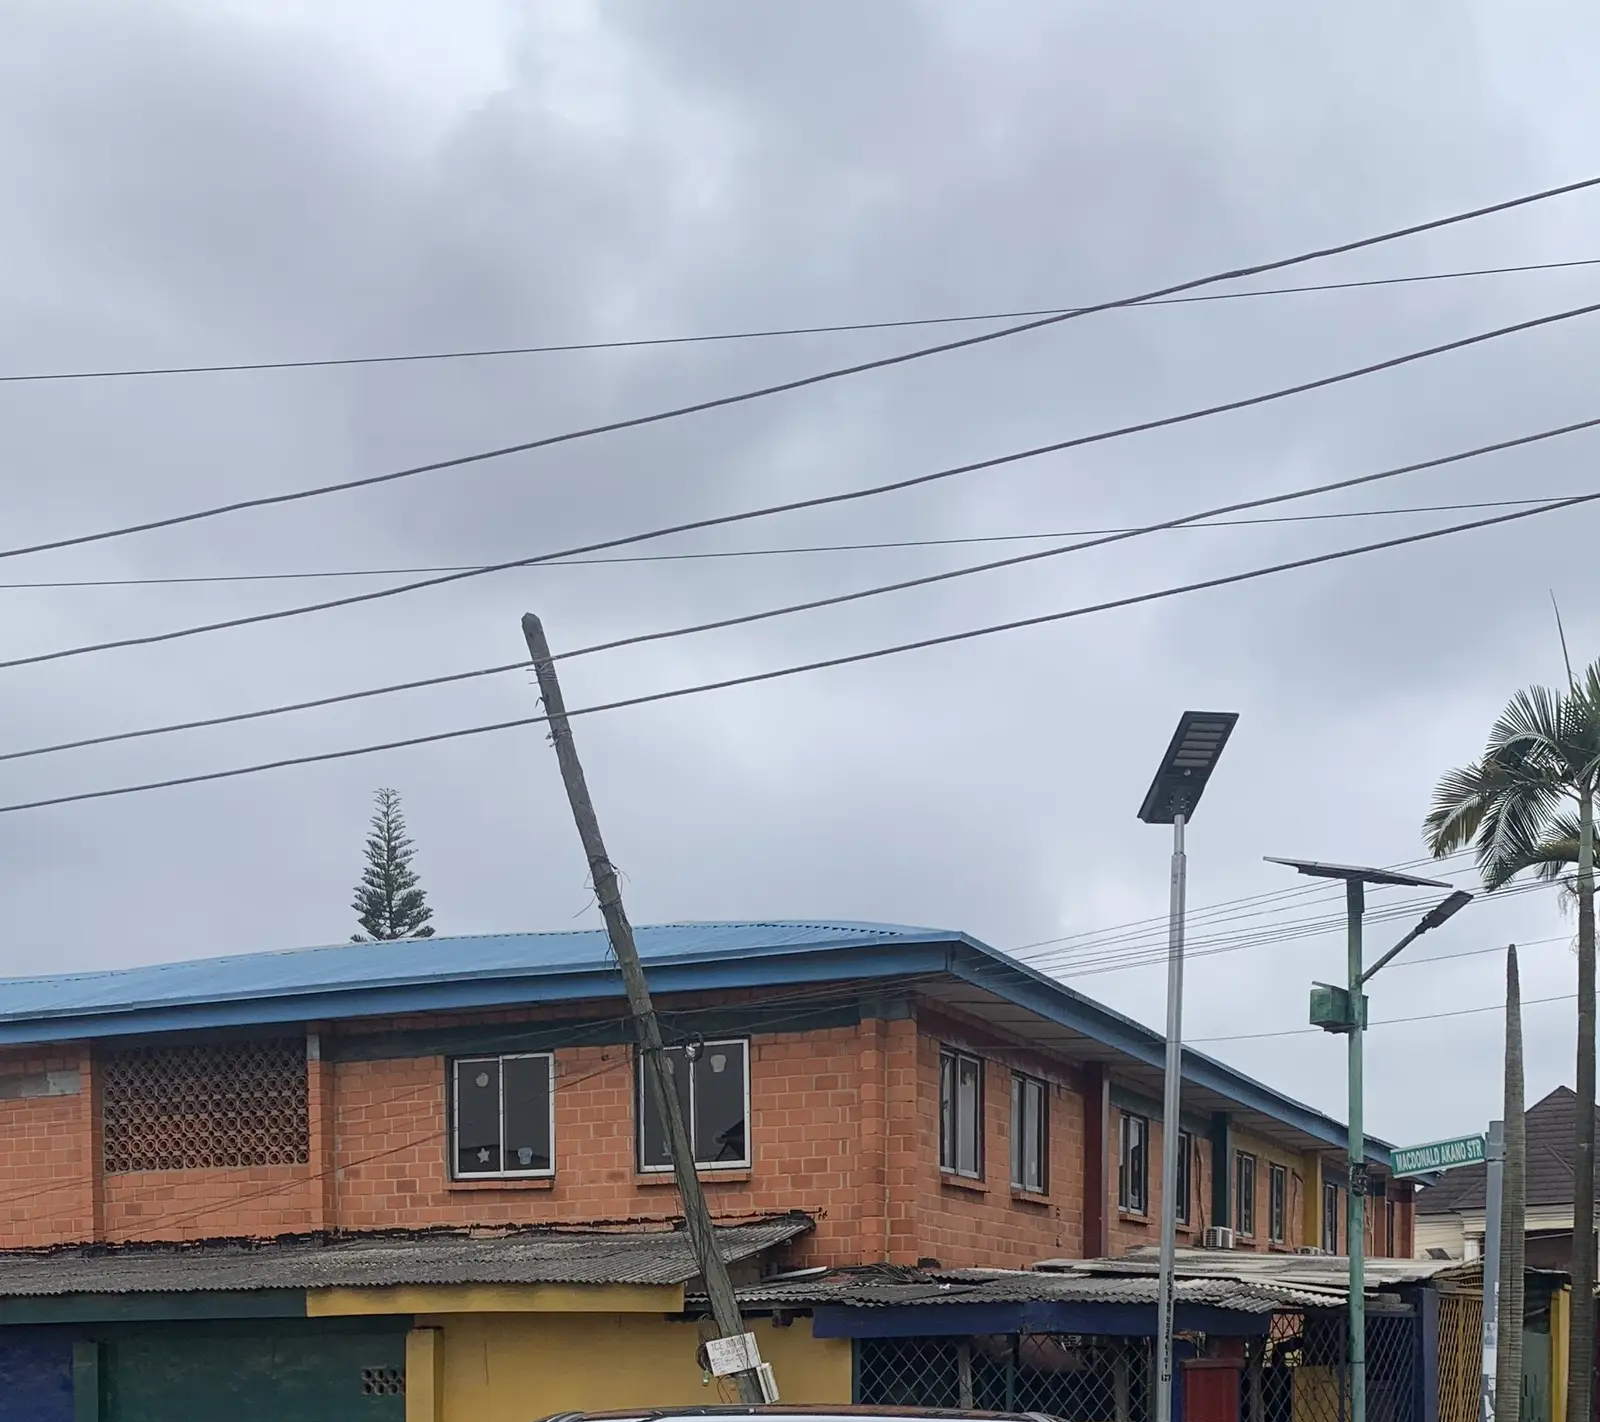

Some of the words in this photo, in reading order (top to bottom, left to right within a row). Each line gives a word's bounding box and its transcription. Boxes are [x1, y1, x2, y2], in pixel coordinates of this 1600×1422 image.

[1395, 1148, 1440, 1171] MACDONALD
[1441, 1143, 1466, 1163] AKANO
[1467, 1139, 1483, 1157] STR
